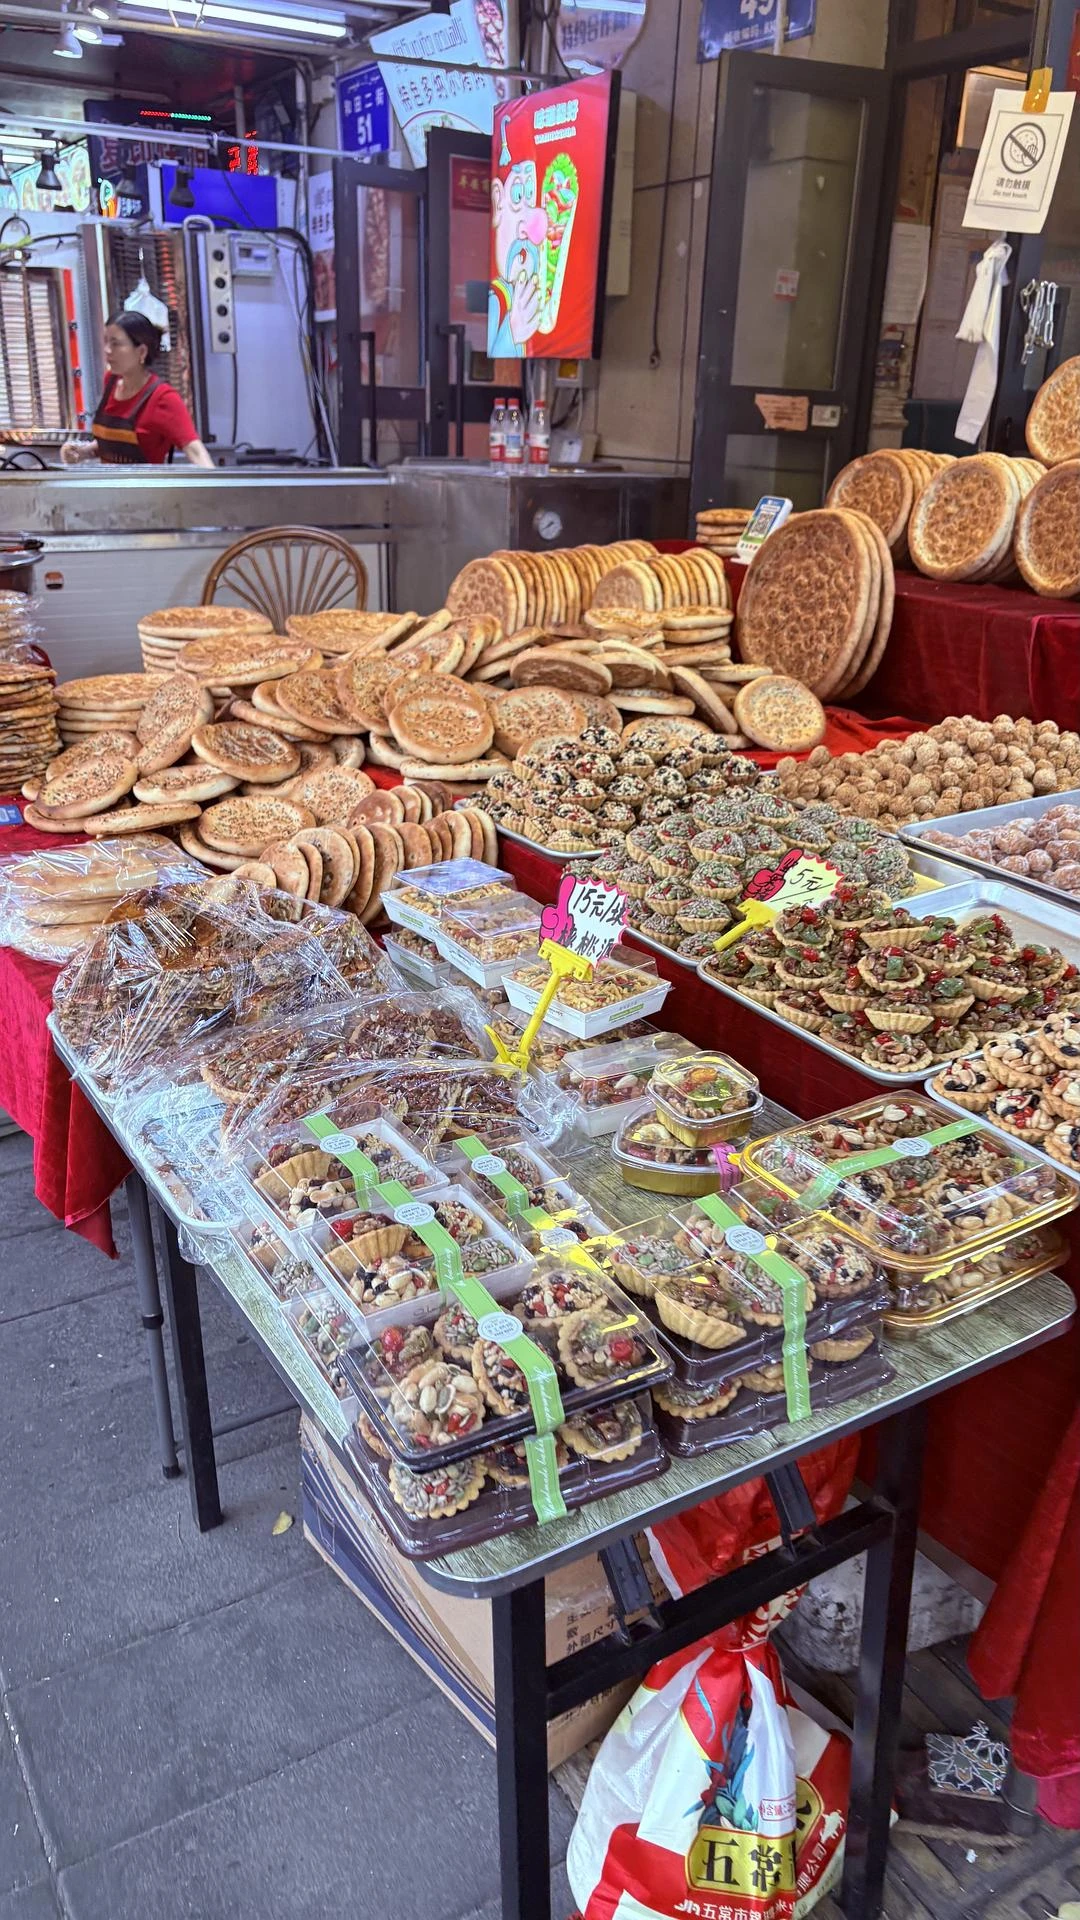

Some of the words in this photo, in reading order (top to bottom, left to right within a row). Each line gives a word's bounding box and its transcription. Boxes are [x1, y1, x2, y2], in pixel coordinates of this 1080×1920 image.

[357, 113, 373, 145] 51
[995, 177, 1031, 190] 请勿触摸
[696, 1838, 797, 1892] 五常
